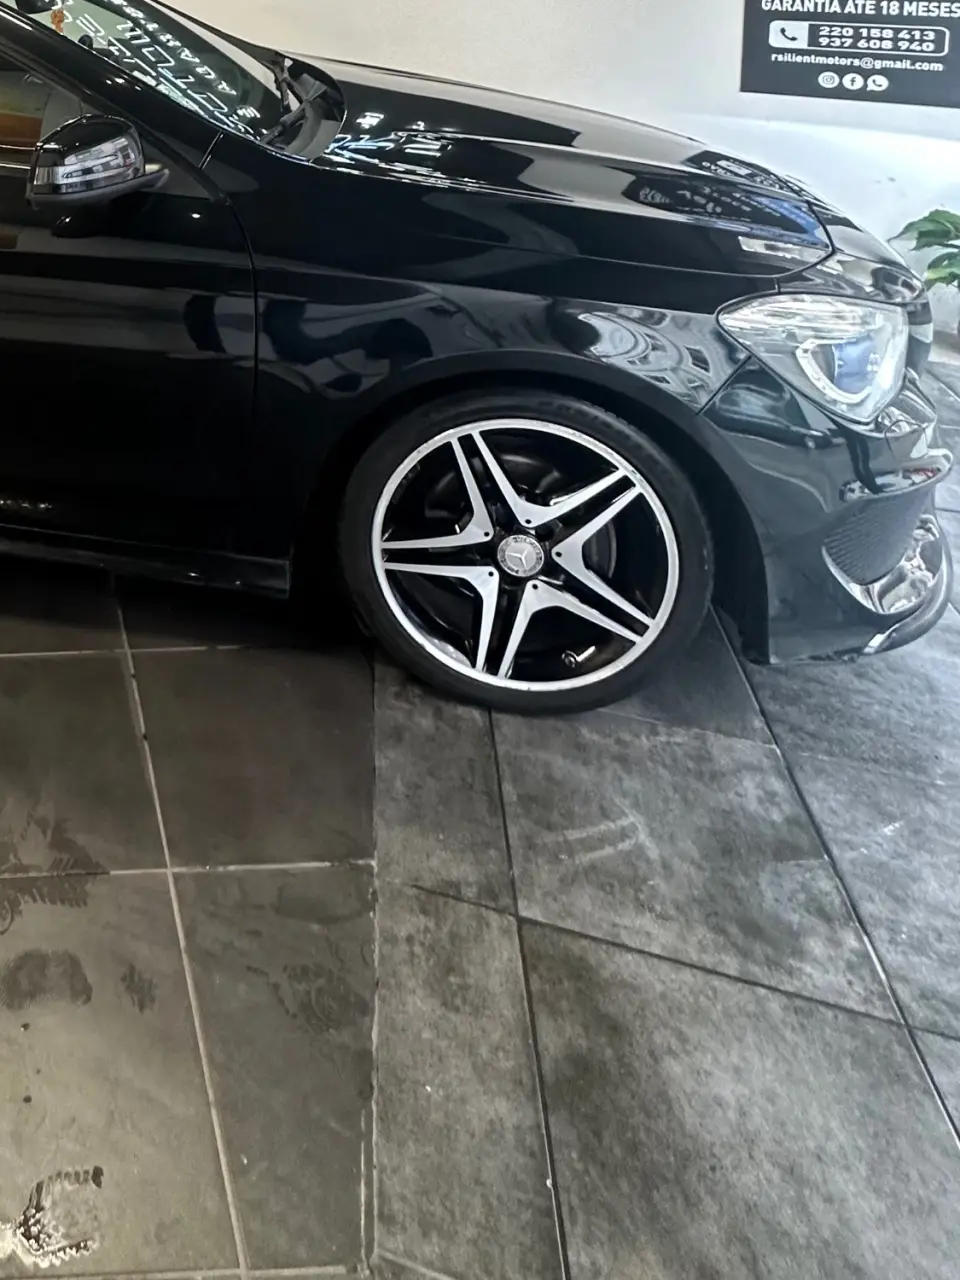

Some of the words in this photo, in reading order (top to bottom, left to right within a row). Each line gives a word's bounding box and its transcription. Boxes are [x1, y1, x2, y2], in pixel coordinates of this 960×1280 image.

[880, 1, 900, 16] 18
[903, 1, 960, 17] MESES
[819, 26, 853, 36] 220
[859, 28, 893, 38] 158
[898, 29, 936, 41] 413
[818, 37, 853, 47] 937
[857, 39, 893, 50] 608
[897, 41, 936, 52] 940
[771, 52, 945, 72] rsilientmotors@gmail.com
